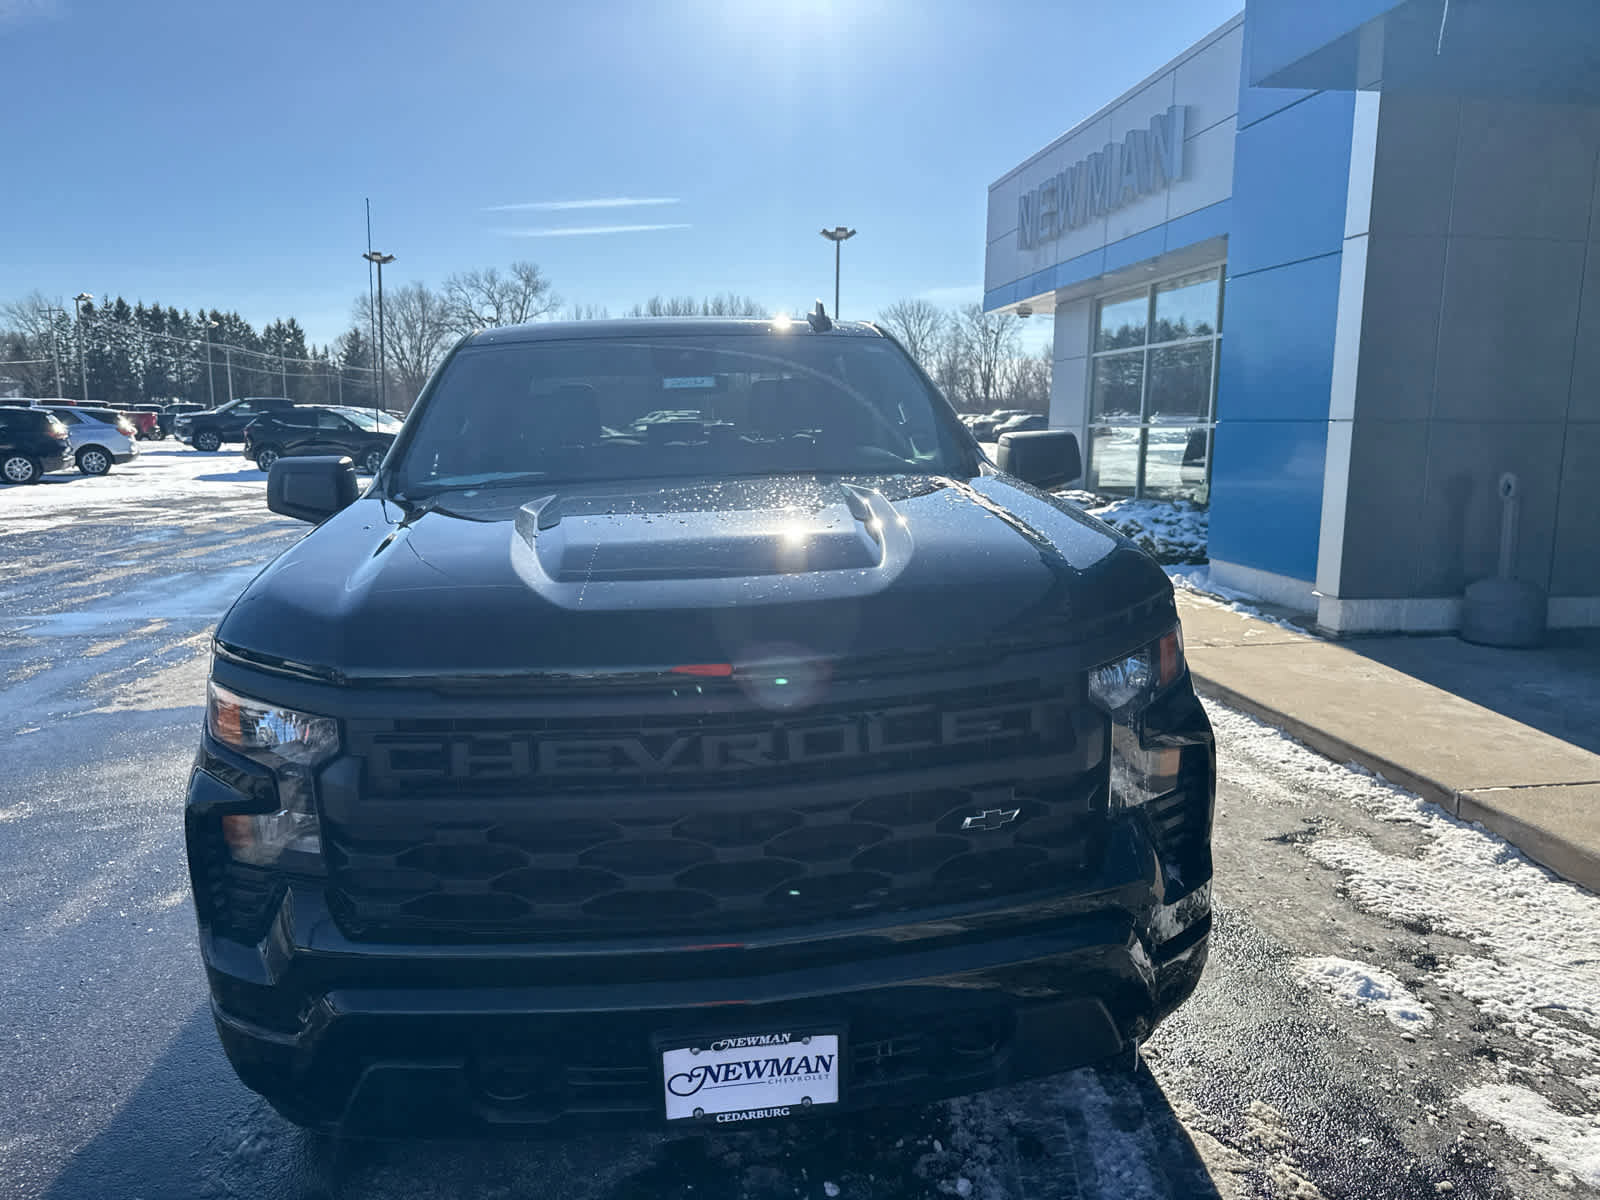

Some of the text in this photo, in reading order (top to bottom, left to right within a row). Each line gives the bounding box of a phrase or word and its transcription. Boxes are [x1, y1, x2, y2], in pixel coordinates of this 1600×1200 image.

[1017, 105, 1187, 250] NEWMAN
[711, 1033, 791, 1052] NEWMAN
[667, 1055, 834, 1096] NEWMAN
[767, 1074, 830, 1085] CHEVROLET
[716, 1107, 790, 1123] CEDARBURG
